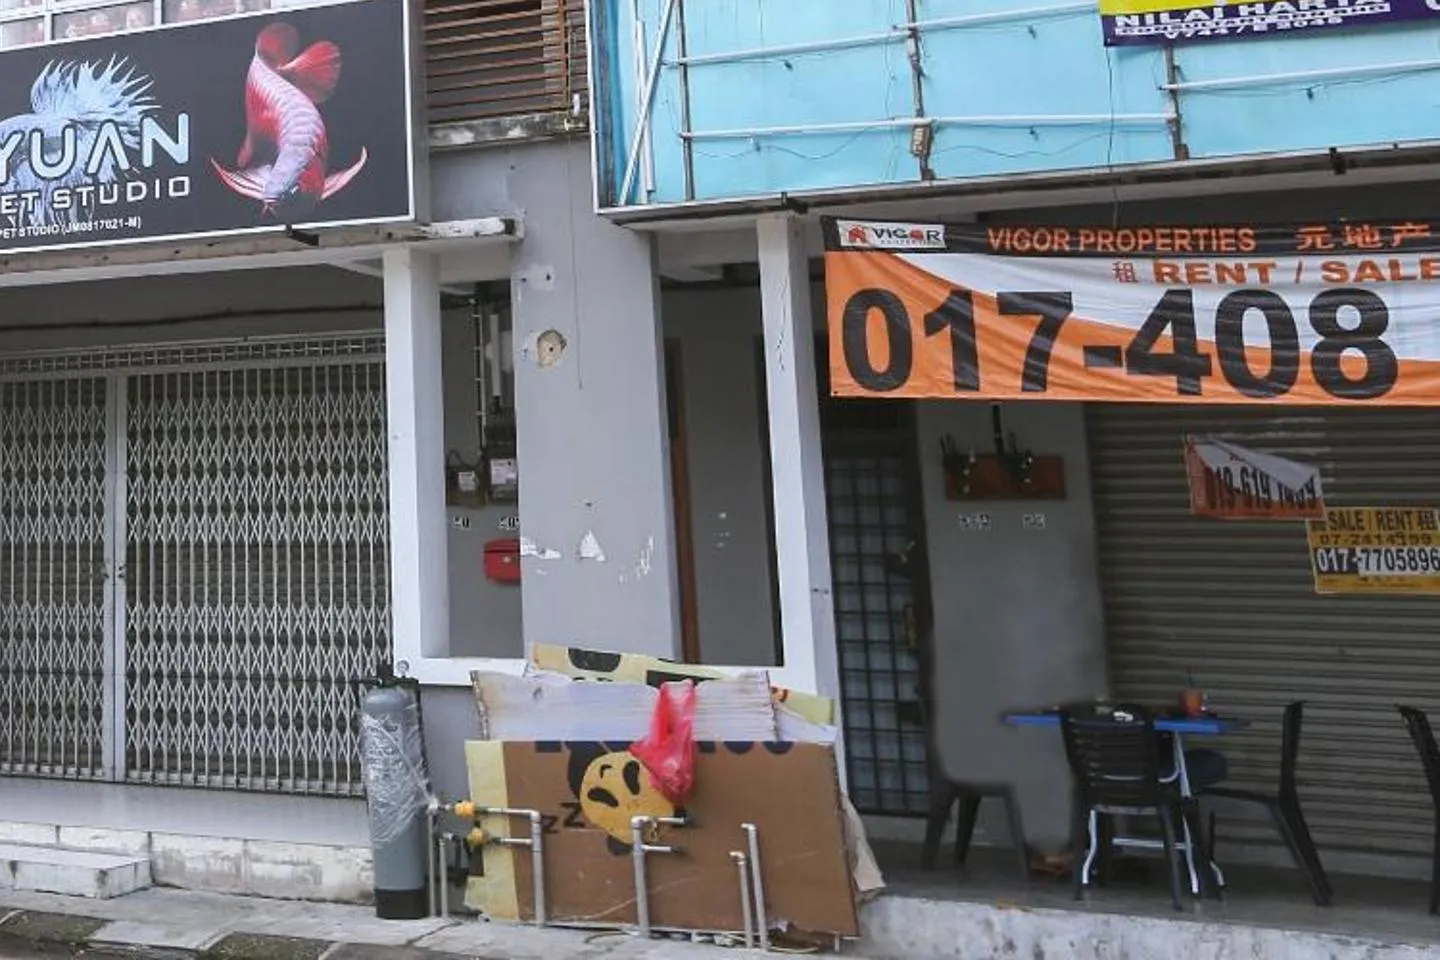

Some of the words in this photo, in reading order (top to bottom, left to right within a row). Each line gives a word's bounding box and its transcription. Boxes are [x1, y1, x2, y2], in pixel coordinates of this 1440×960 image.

[1115, 6, 1224, 27] NILAI
[52, 175, 192, 208] STUDIO
[987, 227, 1071, 252] VIGOR
[1079, 227, 1258, 253] PROPERTIES
[1152, 260, 1278, 285] RENT
[1320, 256, 1440, 284] SALE
[842, 286, 1399, 400] 017-408
[1328, 510, 1365, 531] SALE
[1376, 510, 1413, 531] RENT
